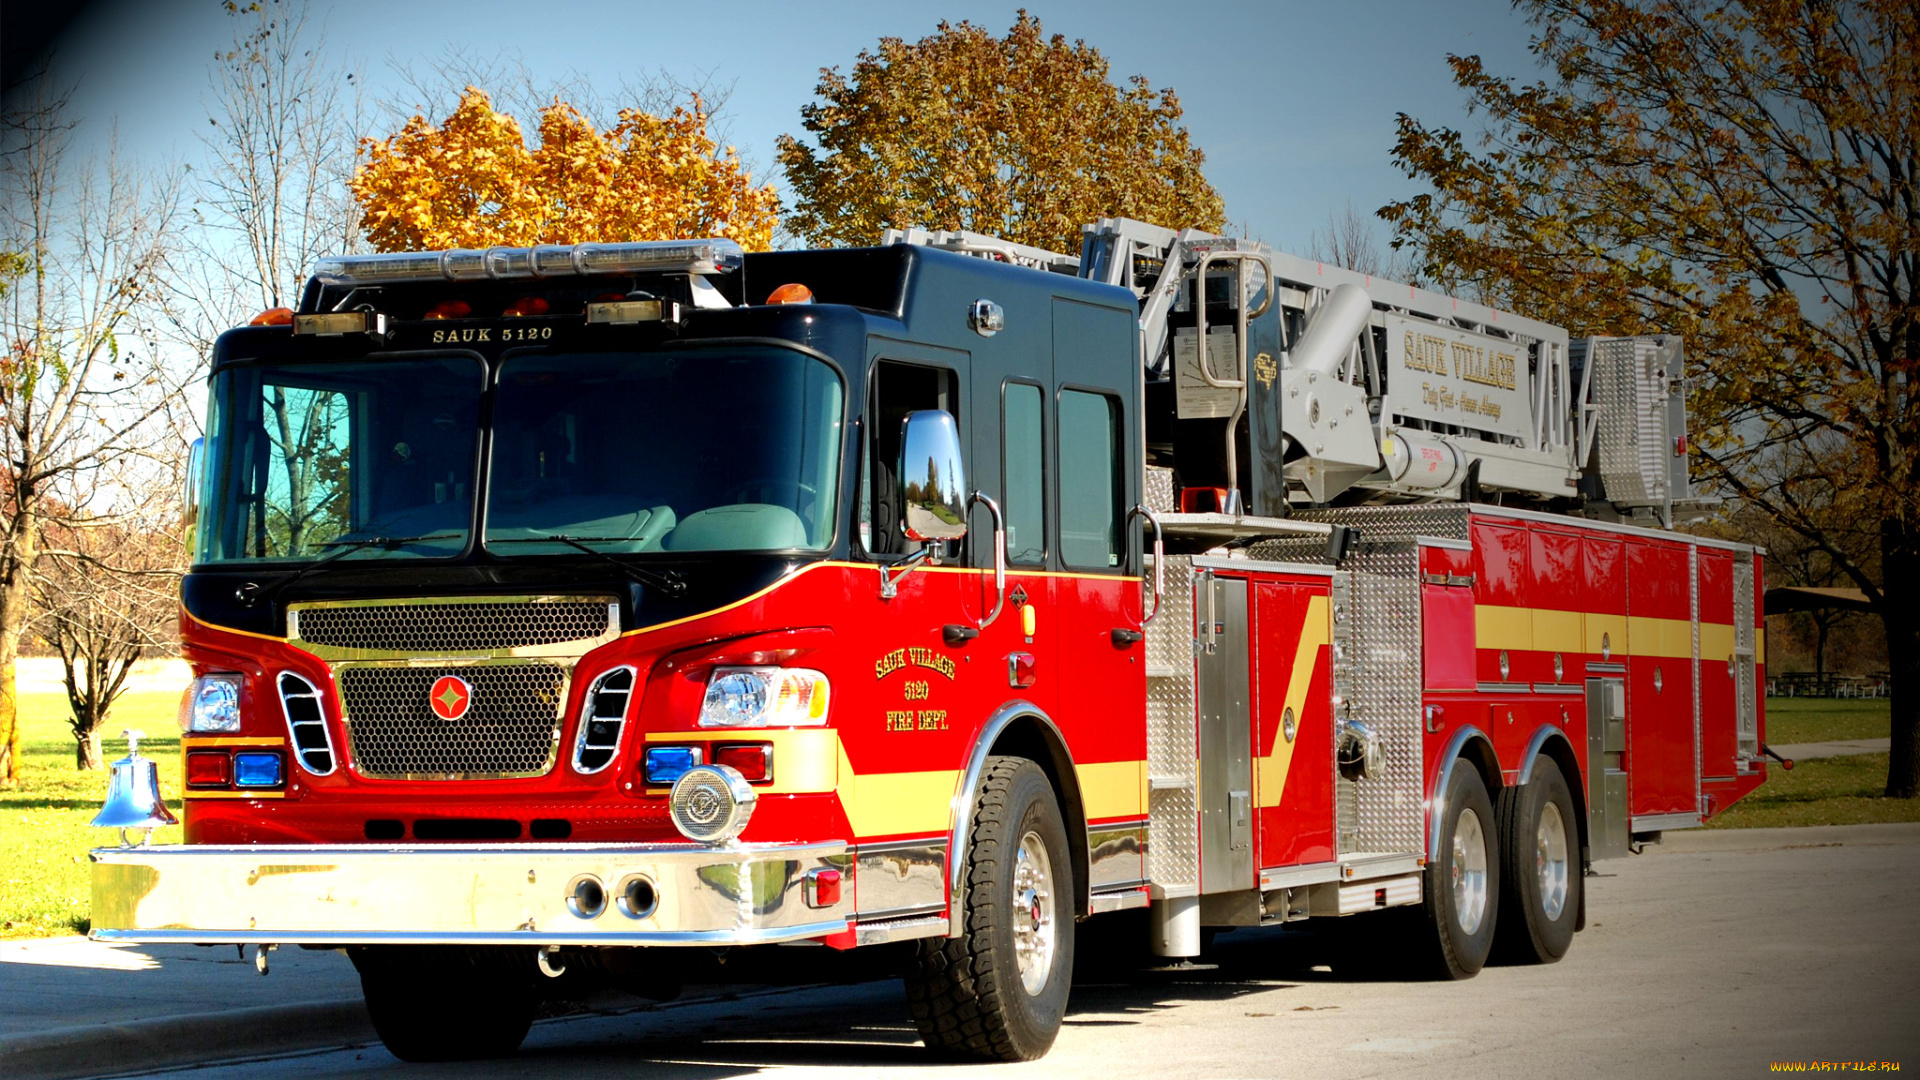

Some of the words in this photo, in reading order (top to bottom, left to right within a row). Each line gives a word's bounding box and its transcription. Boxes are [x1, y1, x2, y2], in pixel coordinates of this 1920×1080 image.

[433, 328, 491, 343] SAUK
[502, 327, 552, 341] 5120
[1404, 329, 1448, 377] SAUK
[1451, 341, 1516, 391] VILLAGE
[875, 648, 906, 680] SAUK
[908, 646, 955, 681] VILLAGE
[904, 680, 929, 701] 5120
[886, 710, 914, 732] FIRE
[917, 709, 949, 731] DEPT.
